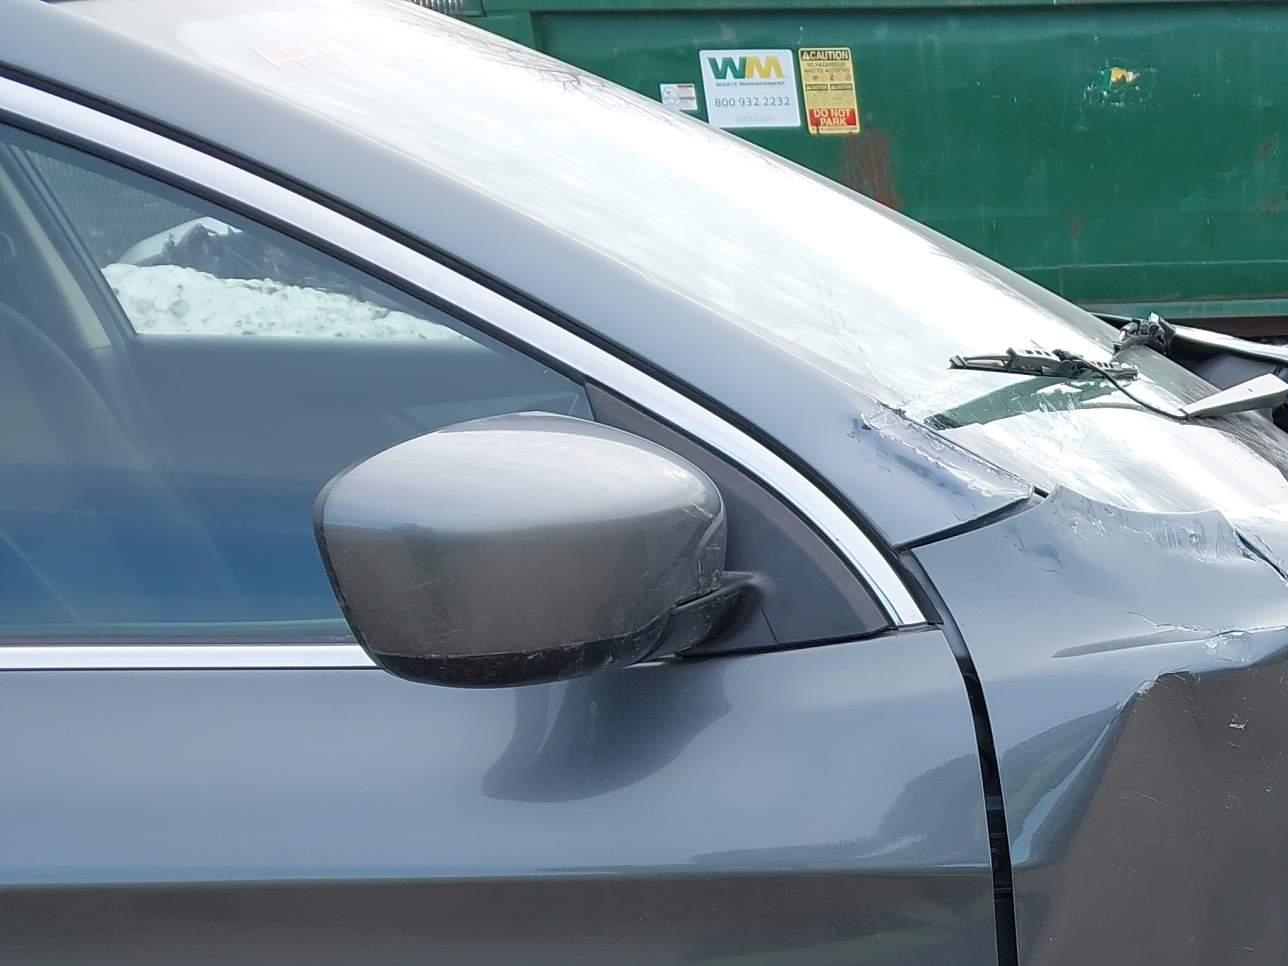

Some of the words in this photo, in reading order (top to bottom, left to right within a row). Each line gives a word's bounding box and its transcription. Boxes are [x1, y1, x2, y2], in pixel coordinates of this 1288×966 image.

[809, 50, 849, 60] CAUTION
[708, 56, 784, 80] WM
[714, 98, 736, 107] 800
[738, 97, 760, 107] 932
[763, 96, 790, 106] 2232
[813, 108, 829, 117] DO
[830, 108, 851, 117] NOT
[819, 118, 848, 126] PARK
